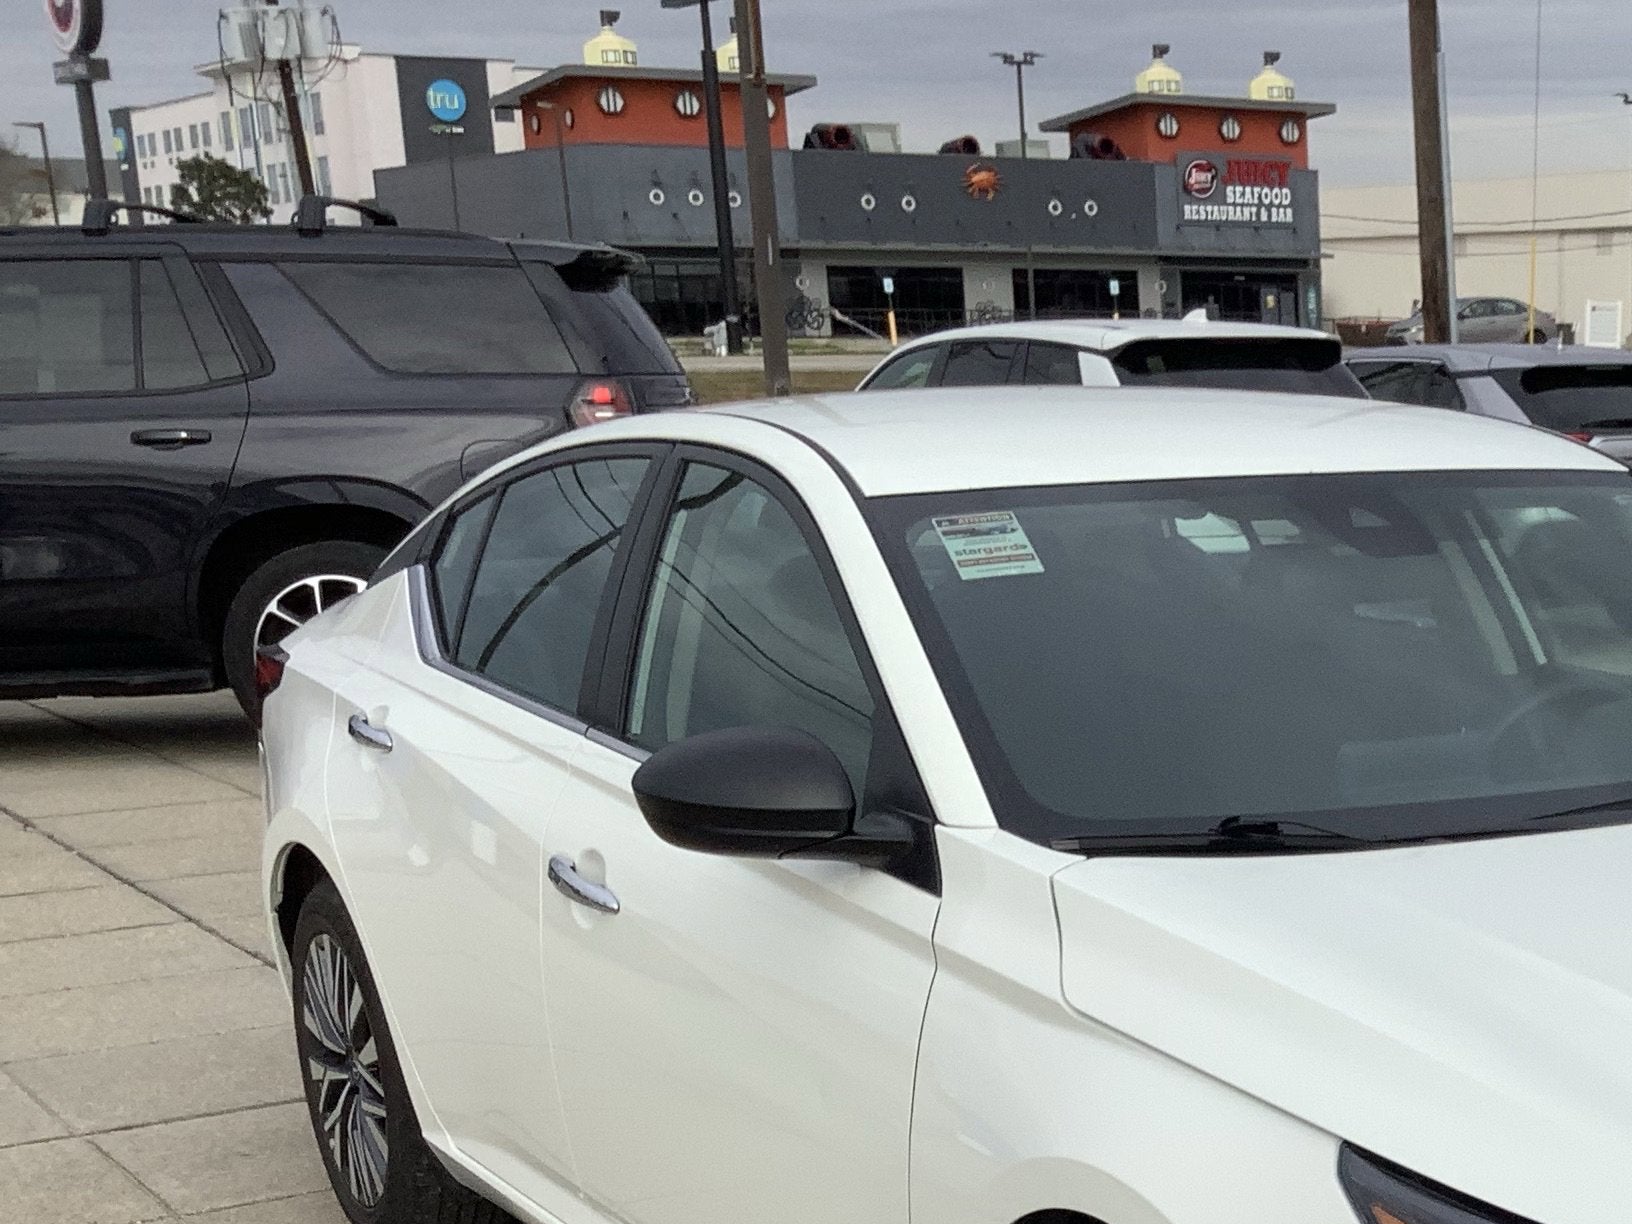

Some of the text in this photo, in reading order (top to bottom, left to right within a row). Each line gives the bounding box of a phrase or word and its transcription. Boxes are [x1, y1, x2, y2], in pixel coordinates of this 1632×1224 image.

[427, 87, 459, 109] tru
[1221, 160, 1292, 187] JUICY
[1226, 186, 1291, 205] SEAFOOD
[1183, 205, 1293, 223] RESTAURANT & BAR
